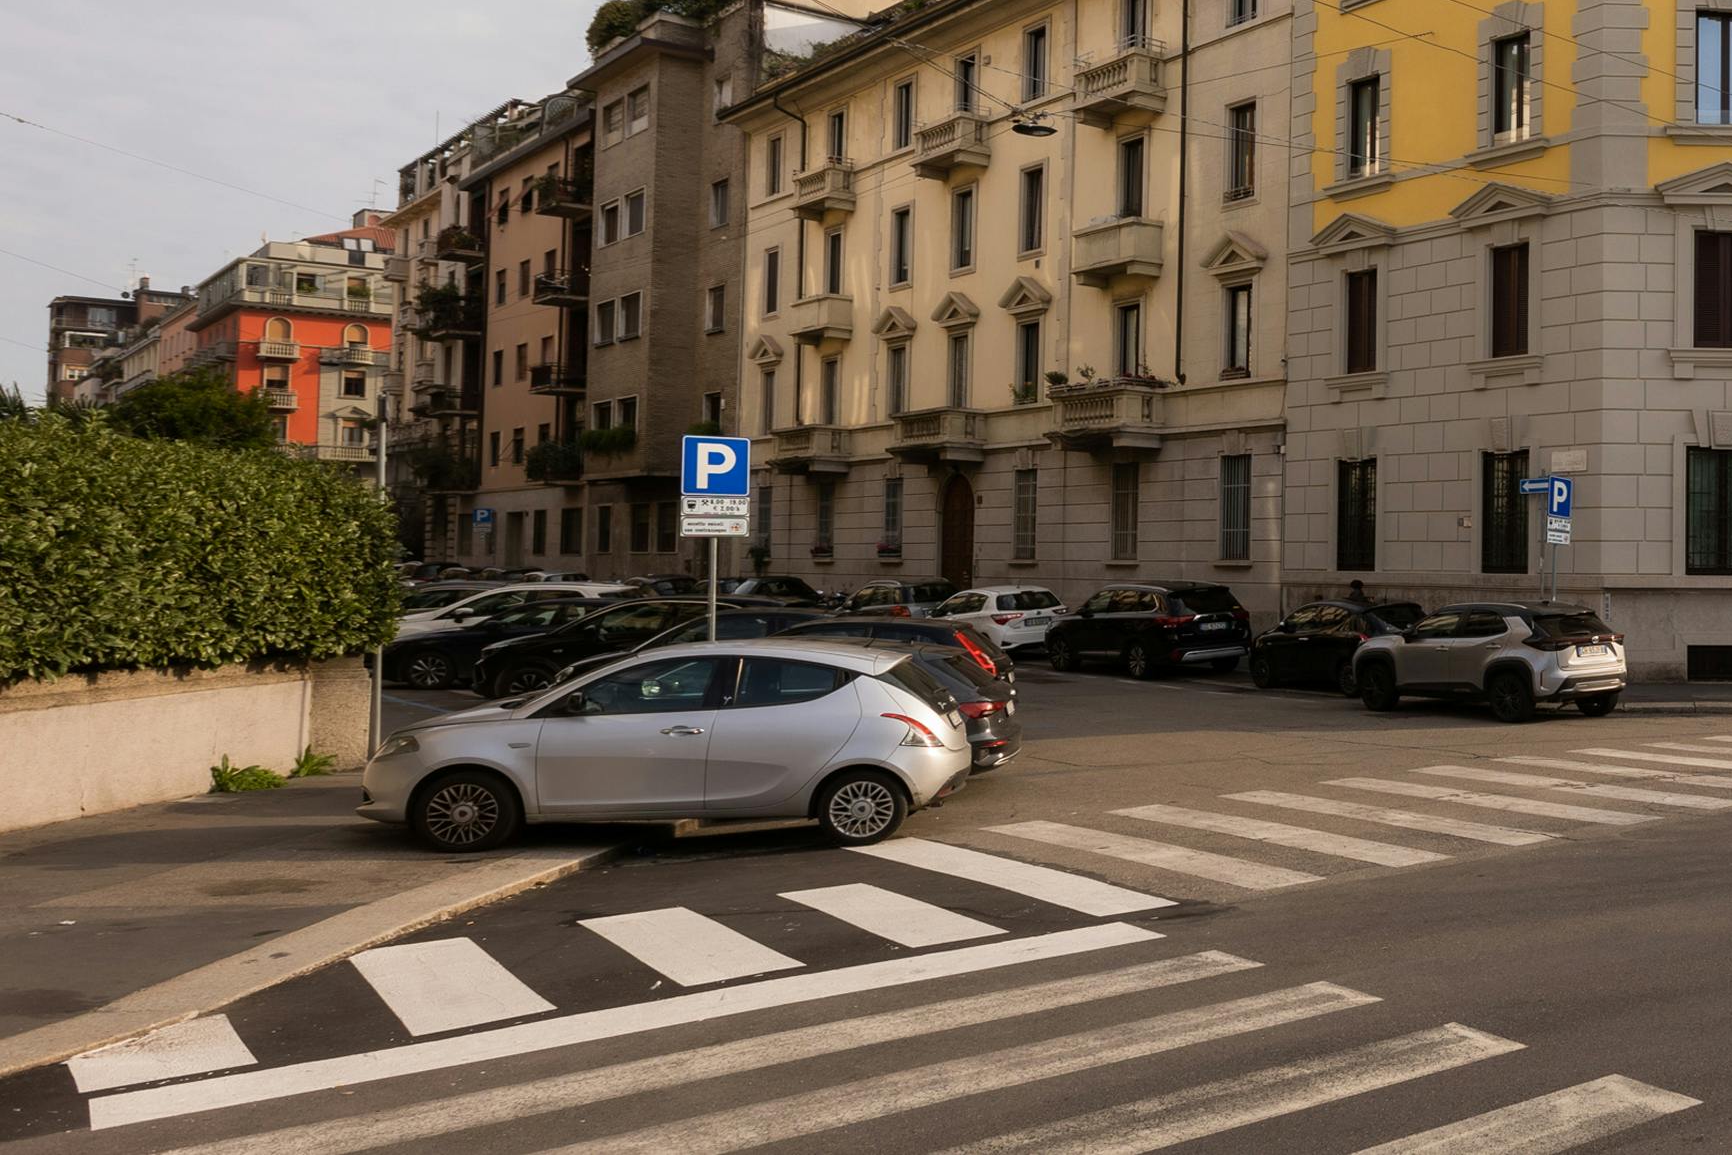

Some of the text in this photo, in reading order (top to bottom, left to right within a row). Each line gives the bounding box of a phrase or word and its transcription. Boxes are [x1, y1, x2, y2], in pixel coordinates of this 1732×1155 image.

[696, 443, 736, 489] P
[1553, 480, 1568, 512] P
[476, 509, 489, 521] P
